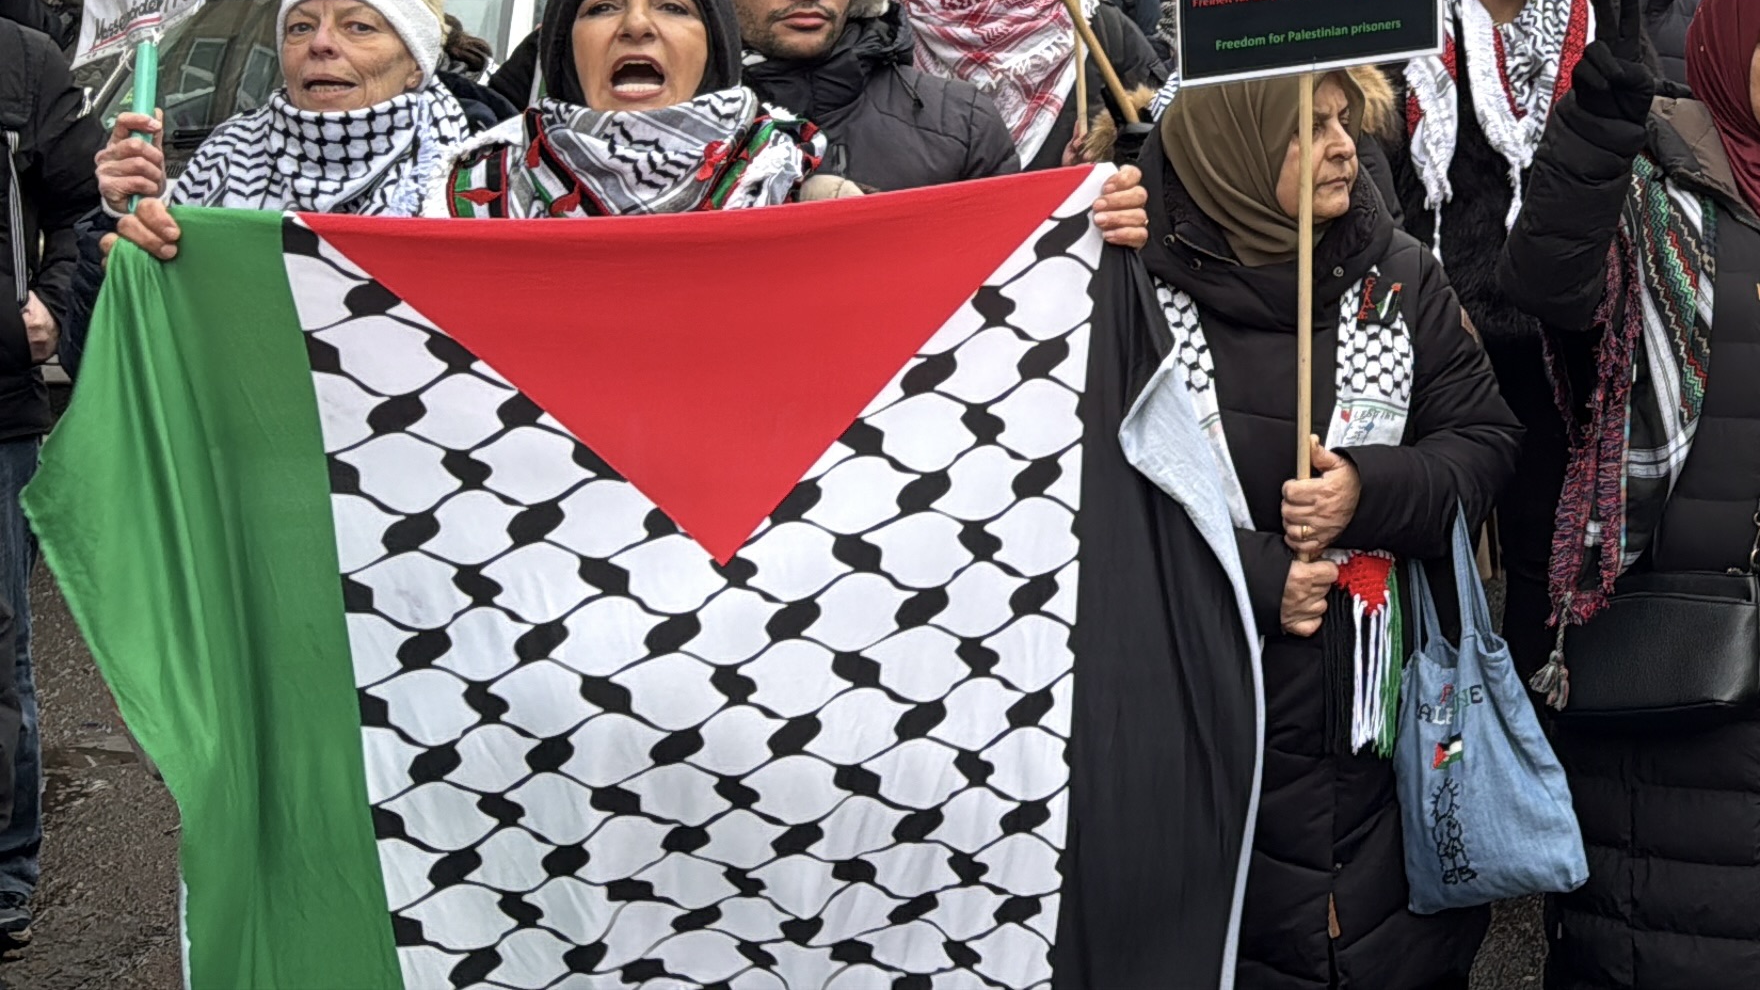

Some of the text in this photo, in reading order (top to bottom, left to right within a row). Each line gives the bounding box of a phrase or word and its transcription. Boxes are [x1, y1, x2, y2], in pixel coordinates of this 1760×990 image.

[1216, 18, 1401, 51] Freedom for Palestinian prisoners
